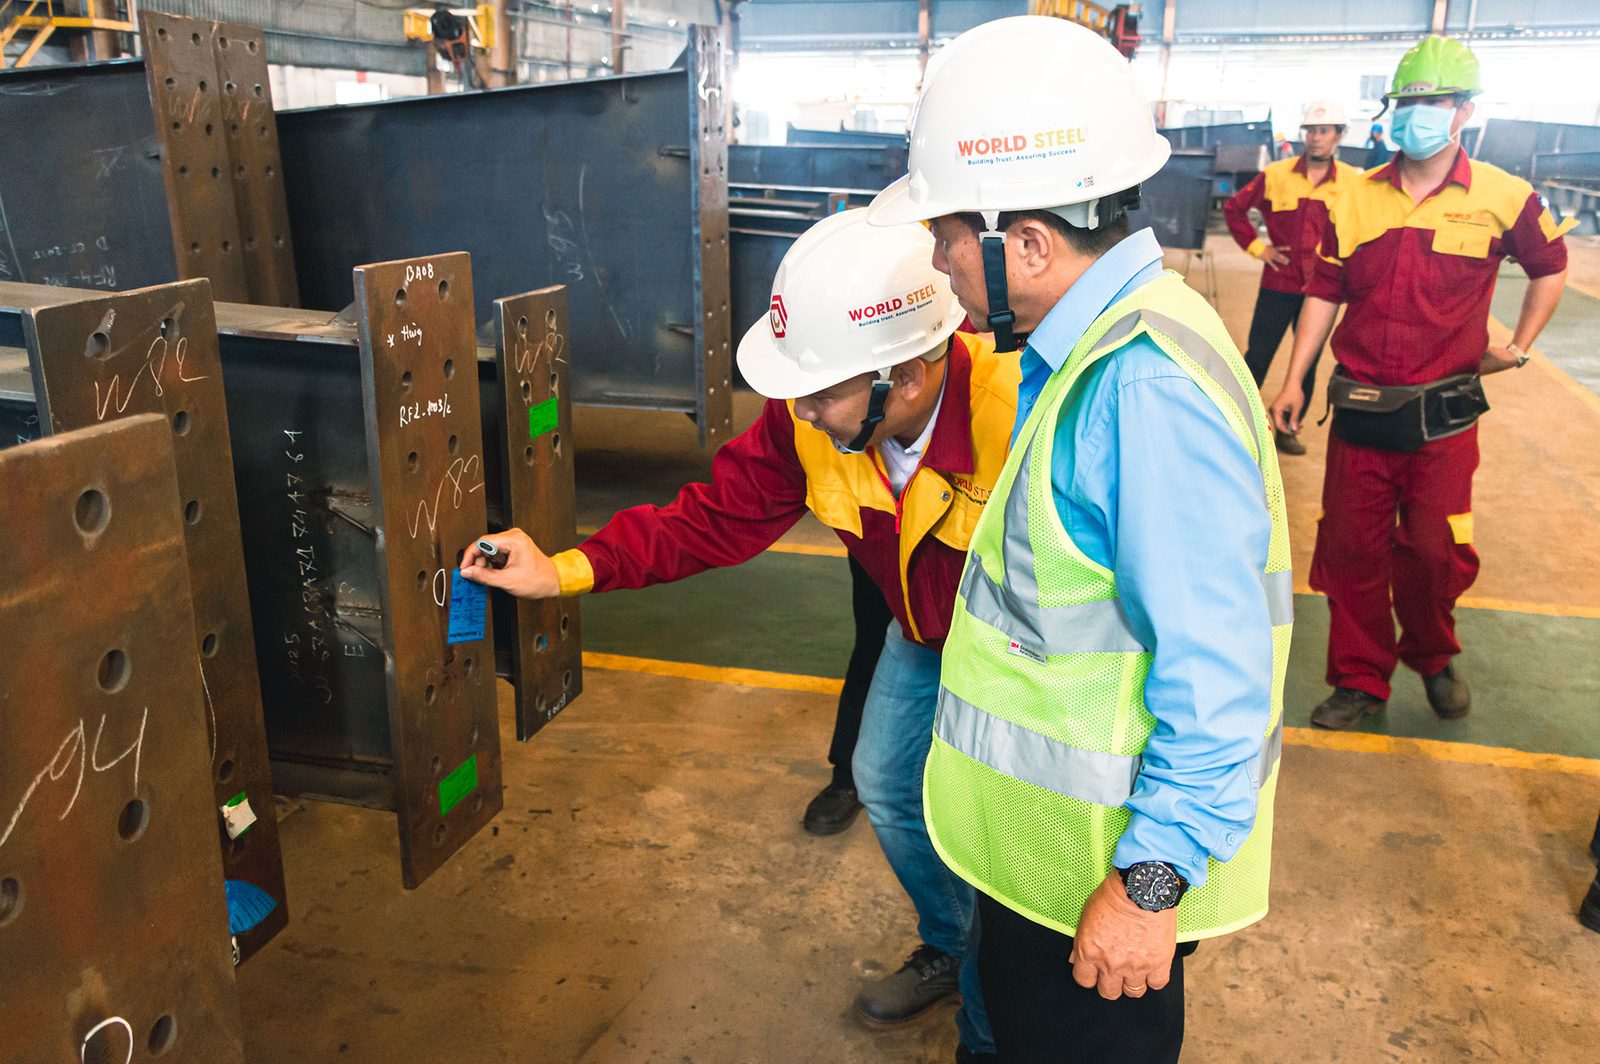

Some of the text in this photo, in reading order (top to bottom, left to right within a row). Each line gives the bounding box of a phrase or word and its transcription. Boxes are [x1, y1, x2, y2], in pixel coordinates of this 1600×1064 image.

[958, 128, 1086, 157] WORLD STEEL
[967, 158, 994, 166] Building
[1016, 152, 1047, 161] Assuring
[1048, 149, 1076, 157] Success
[848, 284, 937, 322] WORLD STEEL
[948, 474, 973, 493] ORLD
